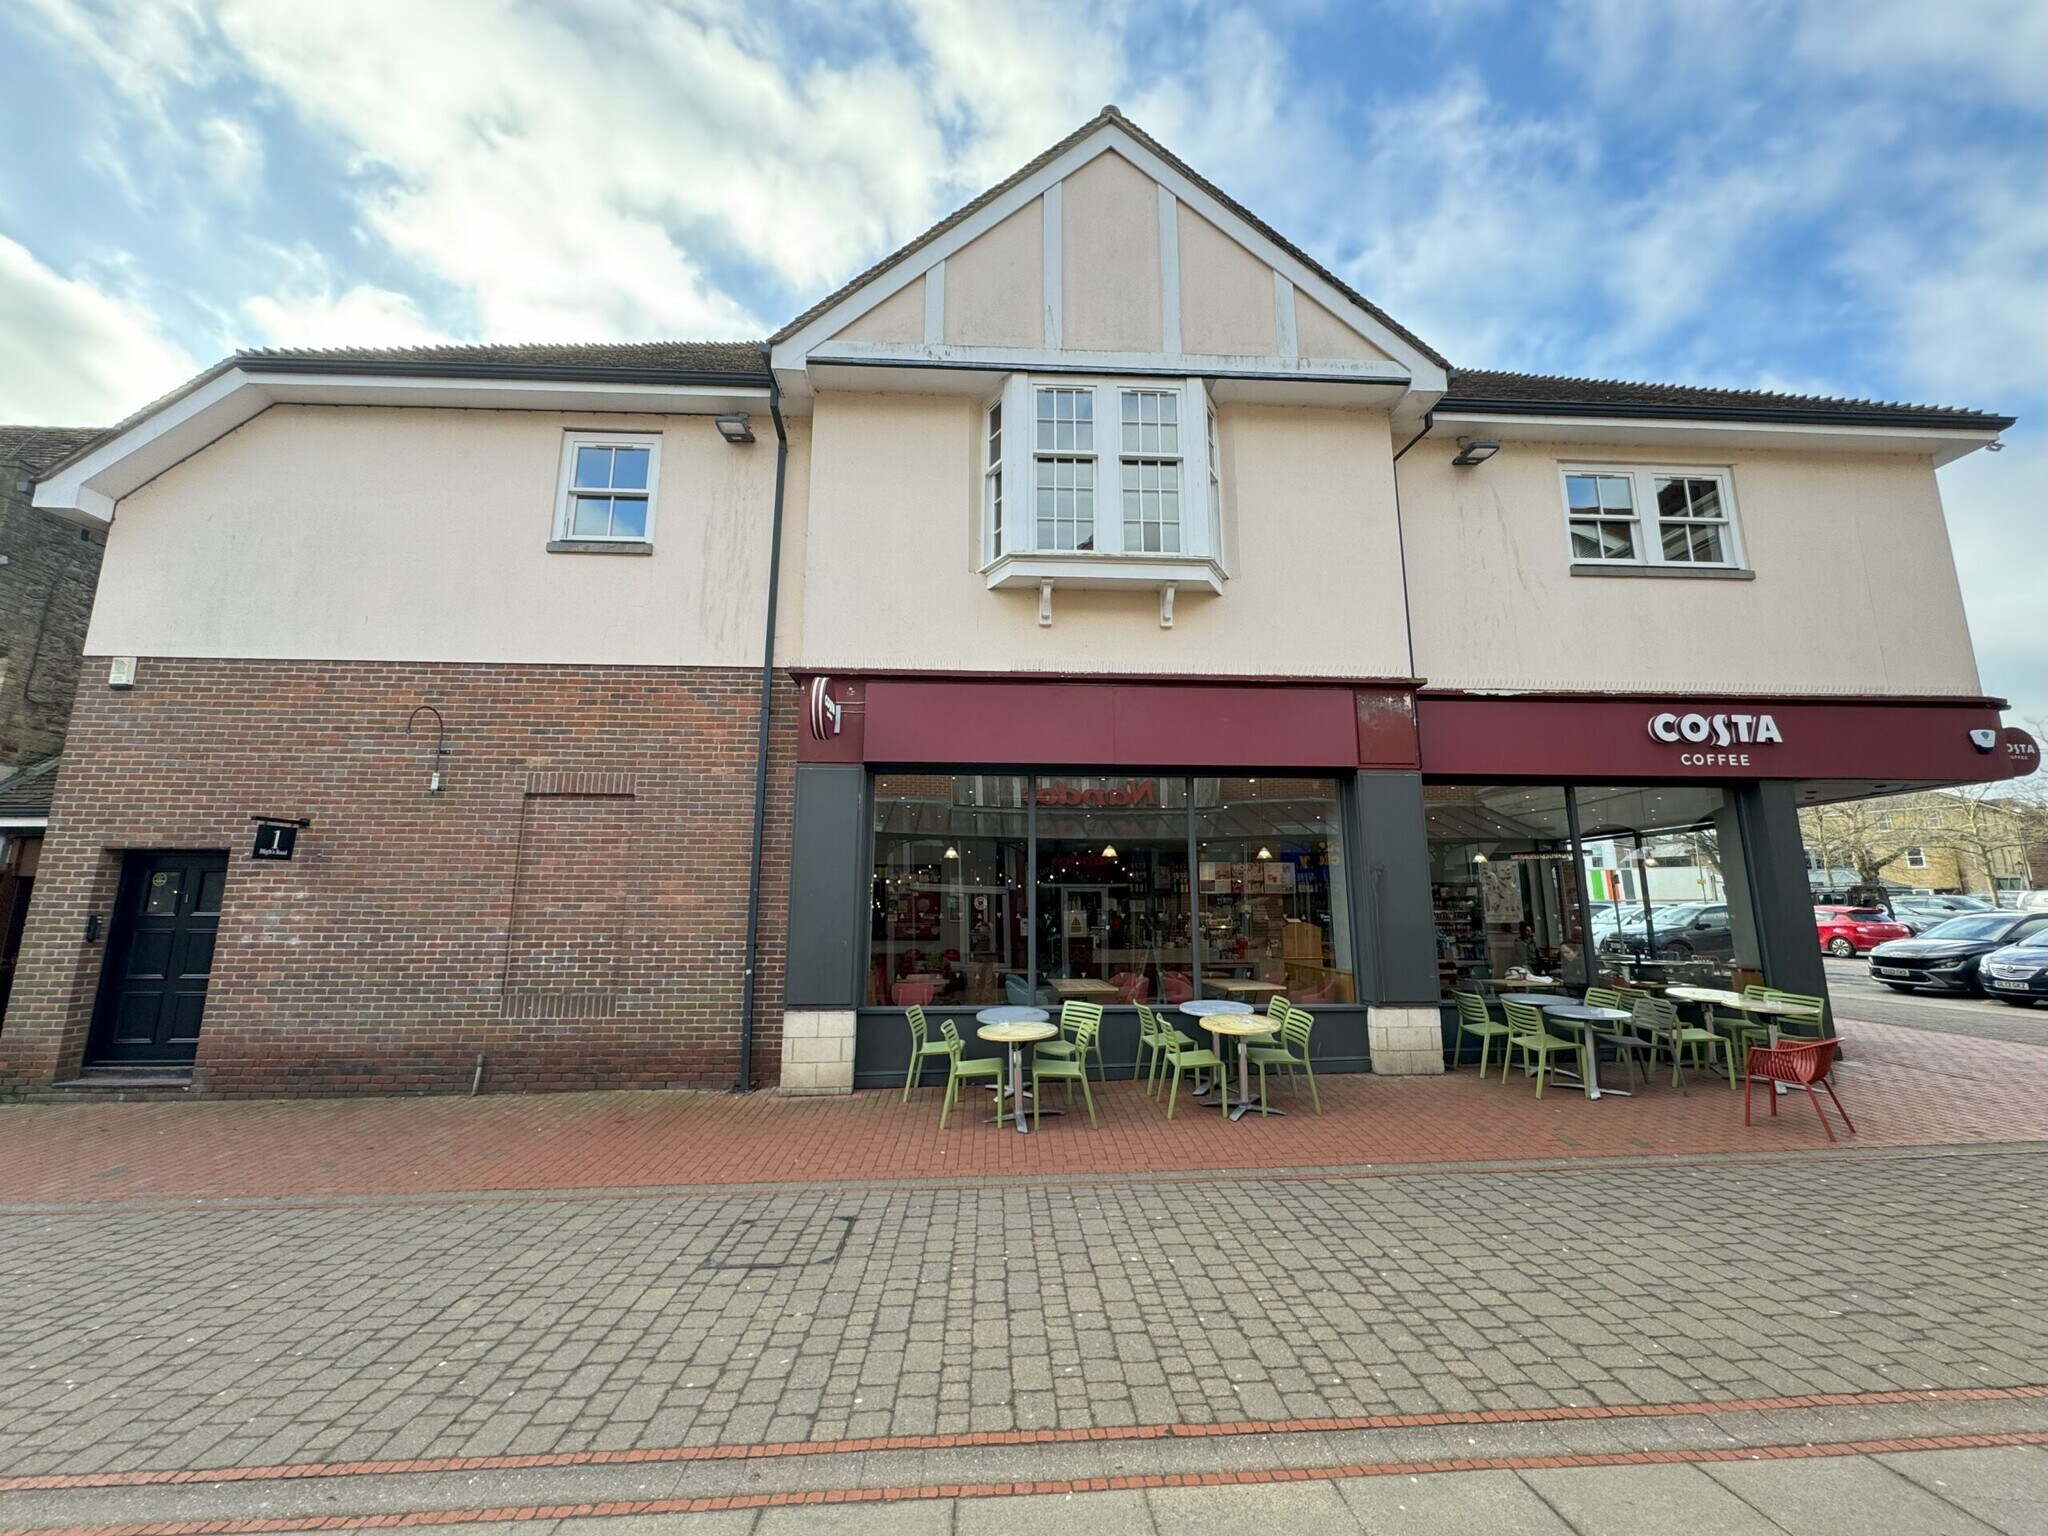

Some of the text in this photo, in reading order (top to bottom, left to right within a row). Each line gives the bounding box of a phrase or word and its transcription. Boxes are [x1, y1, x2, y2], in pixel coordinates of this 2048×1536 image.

[1648, 713, 1783, 747] COSTA
[2006, 743, 2035, 755] OSTA
[1681, 754, 1750, 766] COFFEE
[271, 830, 281, 849] 1
